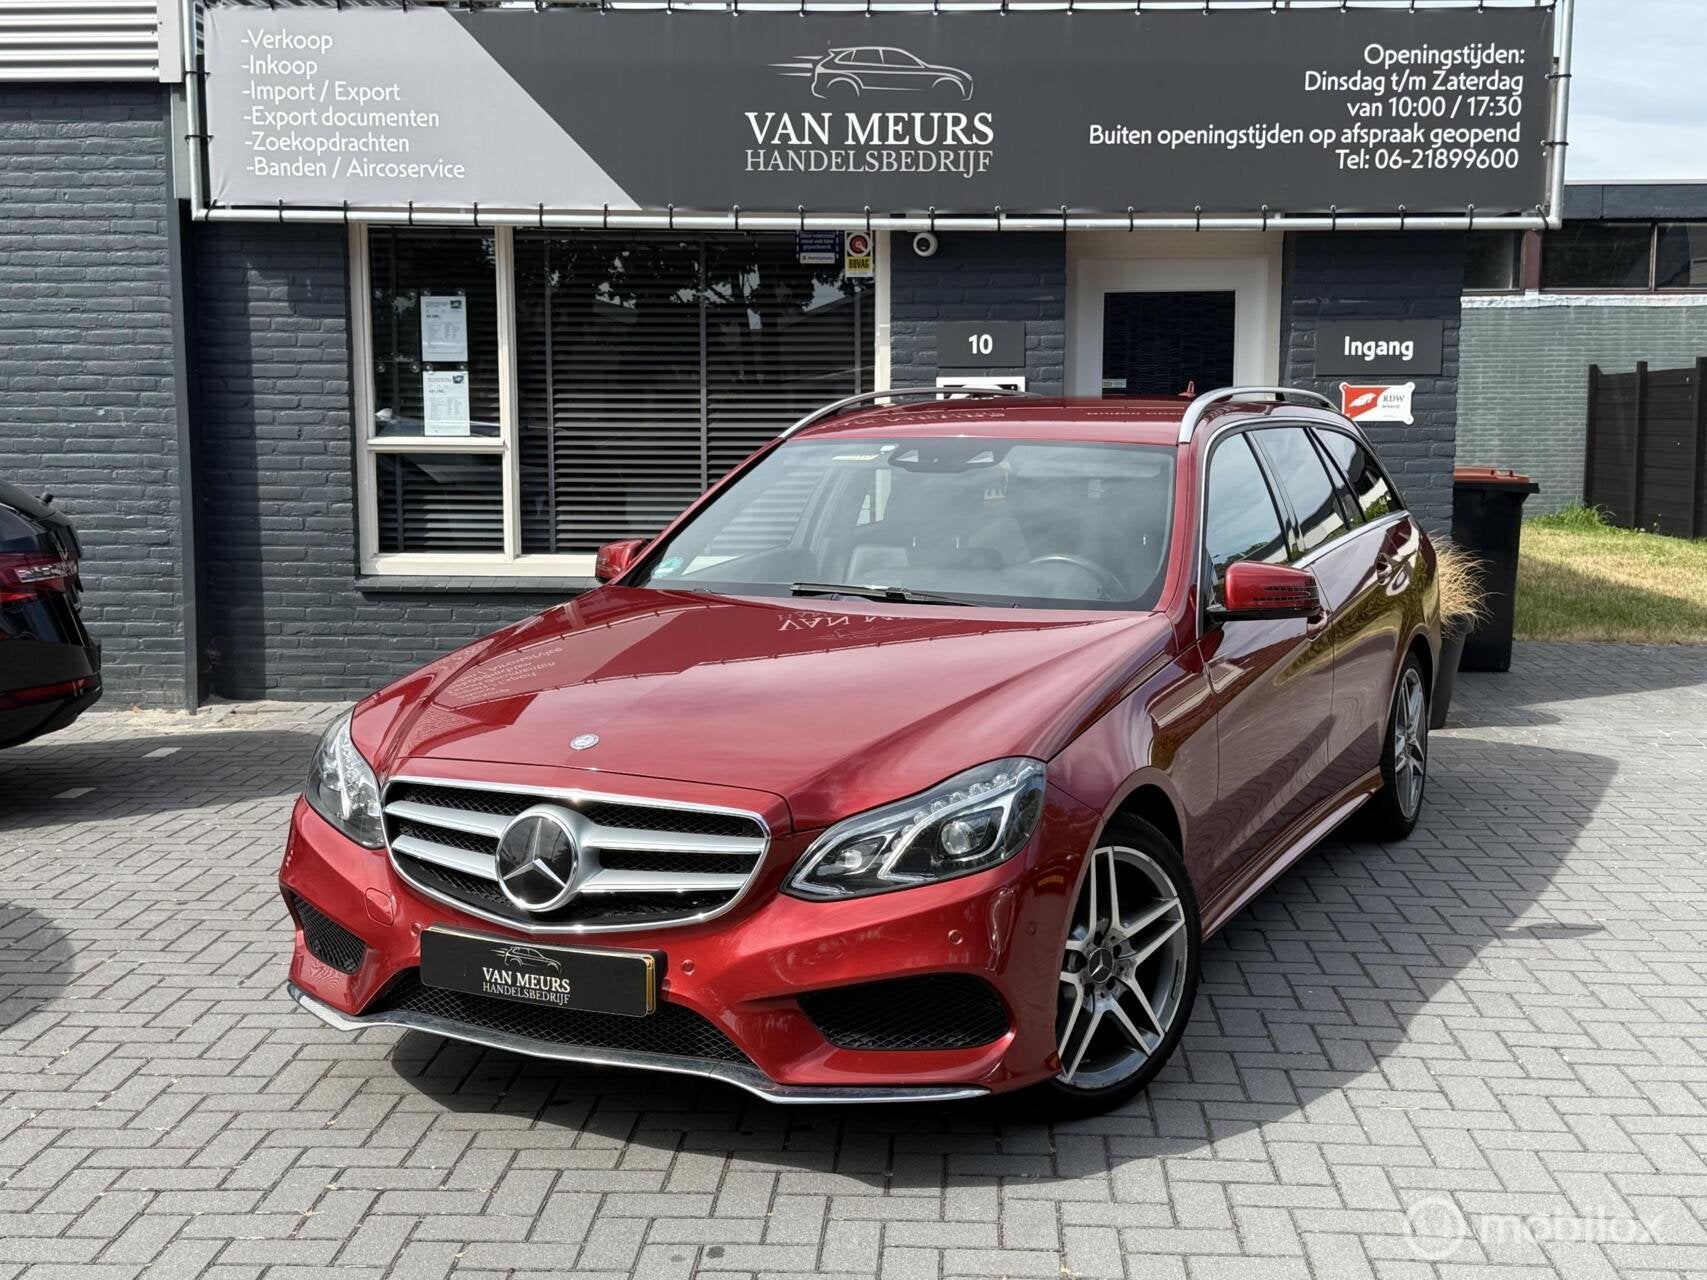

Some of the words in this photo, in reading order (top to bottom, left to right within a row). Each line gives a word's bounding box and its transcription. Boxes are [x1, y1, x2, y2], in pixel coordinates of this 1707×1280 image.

[241, 29, 333, 54] -Verkoop
[242, 55, 318, 79] -Inkoop
[1364, 43, 1525, 70] Openingstijden:
[243, 81, 315, 103] -Import
[320, 80, 330, 102] /
[335, 82, 401, 103] Export
[1305, 71, 1385, 95] Dinsdag
[1391, 71, 1427, 92] t/m
[1432, 71, 1524, 95] Zaterdag
[244, 107, 317, 130] -Export
[322, 106, 439, 127] documenten
[1347, 103, 1383, 117] van
[1389, 97, 1446, 117] 10:00
[1451, 96, 1462, 119] /
[1467, 97, 1522, 117] 17:30
[745, 112, 832, 145] VAN
[845, 113, 994, 145] MEURS
[1090, 125, 1152, 145] Buiten
[1158, 123, 1303, 149] openingstijden
[1310, 129, 1336, 147] op
[1341, 123, 1425, 148] afspraak
[1430, 124, 1521, 148] geopend
[245, 131, 410, 156] -Zoekopdrachten
[247, 157, 327, 177] -Banden
[332, 157, 341, 178] /
[347, 158, 465, 178] Aircoservice
[745, 150, 993, 178] HANDELSBEDRIJF
[1335, 150, 1370, 169] Tel:
[1375, 149, 1519, 169] 06-21899600
[968, 334, 993, 354] 10
[1344, 336, 1414, 361] Ingang
[482, 967, 512, 985] VAN
[516, 972, 571, 993] MEURS
[482, 982, 571, 1006] HANDELSBEDRIJF
